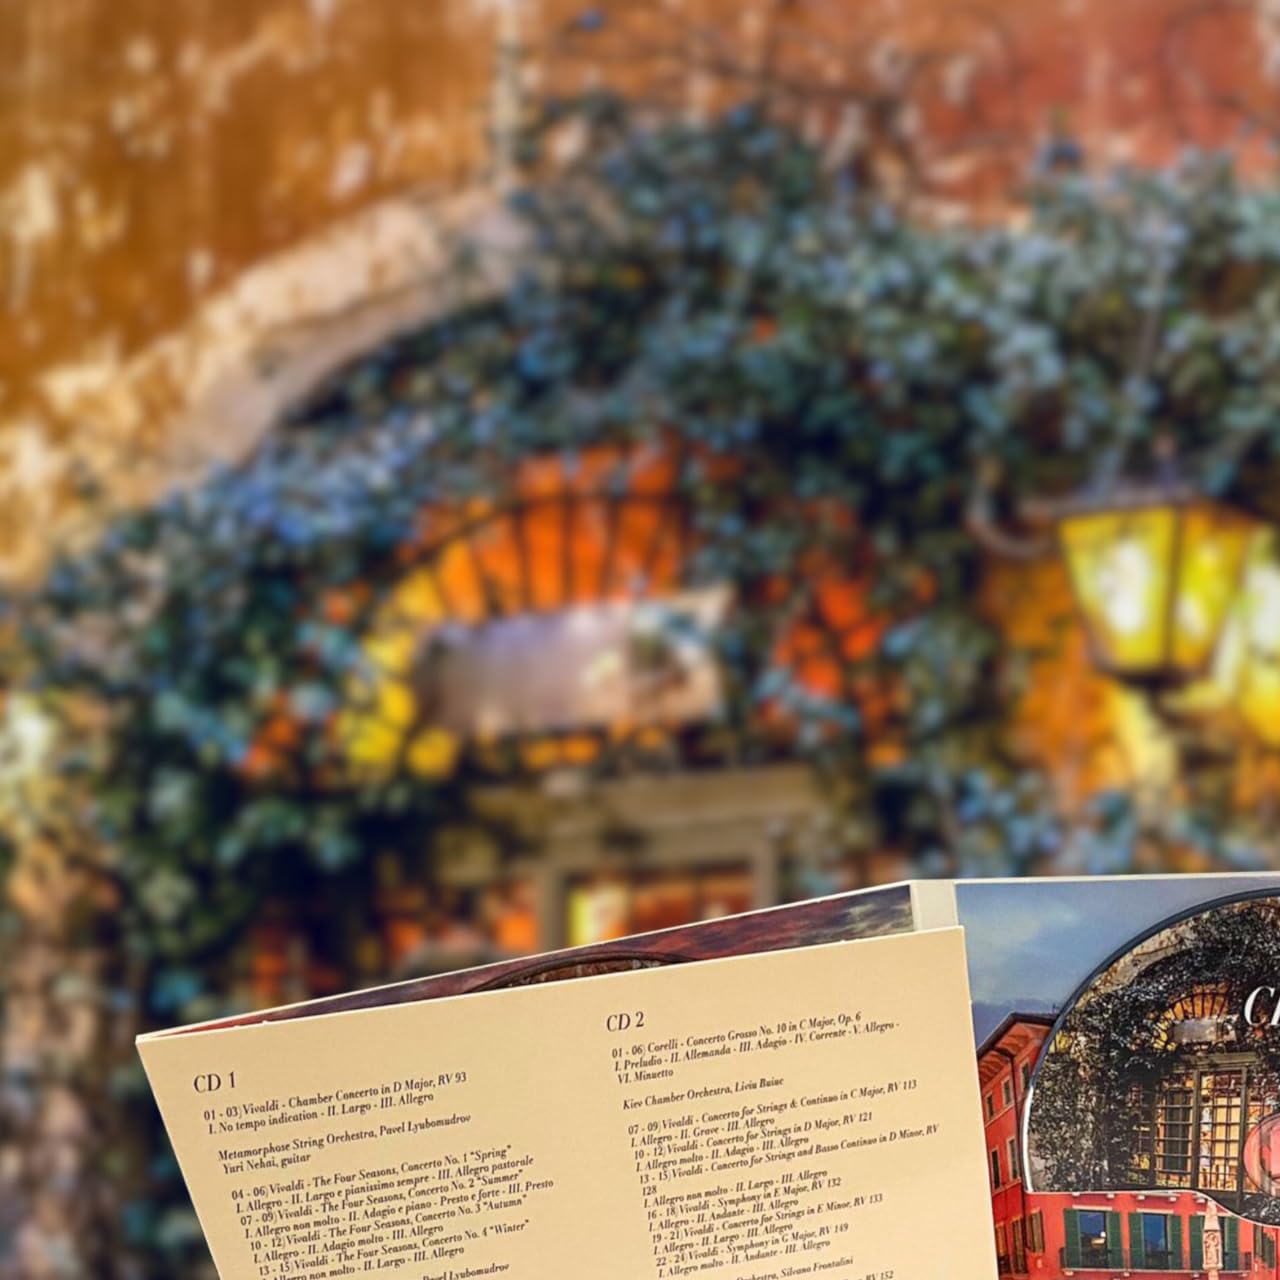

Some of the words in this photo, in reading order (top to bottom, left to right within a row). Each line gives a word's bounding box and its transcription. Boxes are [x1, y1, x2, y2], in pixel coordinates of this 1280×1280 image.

[606, 1013, 631, 1032] CD
[635, 1011, 644, 1028] 2
[611, 1048, 622, 1058] 01
[647, 1038, 678, 1053] Corelli
[686, 1034, 726, 1047] Concerto
[727, 1030, 758, 1041] Grosso
[777, 1022, 787, 1034] 10
[623, 1055, 663, 1071] Preludio
[683, 1044, 731, 1061] Allemanda
[755, 1036, 787, 1050] Adagio
[809, 1025, 848, 1041] Corrente
[864, 1021, 894, 1034] Allegro
[193, 1073, 222, 1093] CD
[229, 1071, 235, 1088] 1
[634, 1069, 674, 1082] Minuetto
[203, 1109, 216, 1121] 01
[242, 1099, 279, 1115] Vivaldi
[288, 1092, 334, 1108] Chamber
[335, 1088, 379, 1101] Concerto
[438, 1073, 453, 1086] RV
[455, 1072, 467, 1083] 93
[644, 1091, 685, 1106] Chamber
[219, 1121, 234, 1133] No
[235, 1119, 266, 1132] tempo
[268, 1110, 318, 1126] indication
[341, 1103, 372, 1115] Largo
[398, 1093, 434, 1106] Allegro
[628, 1124, 639, 1135] 07
[660, 1115, 694, 1129] Vivaldi
[701, 1111, 740, 1123] Concerto
[740, 1105, 755, 1120] for
[755, 1102, 788, 1118] Strings
[800, 1094, 839, 1107] Continuo
[887, 1082, 901, 1092] RV
[218, 1142, 290, 1160] Metamorphose
[292, 1136, 325, 1150] String
[379, 1122, 405, 1136] Pavel
[692, 1126, 719, 1138] Grave
[706, 1135, 744, 1148] Concerto
[760, 1126, 792, 1142] Strings
[842, 1114, 856, 1125] RV
[858, 1112, 872, 1122] 121
[840, 1137, 878, 1149] Continuo
[223, 1161, 244, 1174] Yuri
[280, 1153, 311, 1169] guitar
[231, 1189, 244, 1200] 04
[269, 1179, 305, 1194] Vivaldi
[312, 1175, 332, 1187] The
[334, 1173, 357, 1184] Four
[400, 1160, 442, 1173] Concerto
[246, 1199, 283, 1216] Allegro
[305, 1191, 336, 1206] Largo
[343, 1180, 395, 1200] pianissimo
[396, 1175, 430, 1190] sempre
[455, 1166, 489, 1179] Allegro
[491, 1156, 534, 1175] pastorale
[642, 1185, 657, 1197] 128
[747, 1179, 774, 1191] Largo
[341, 1198, 365, 1210] Four
[408, 1185, 449, 1198] Concerto
[362, 1205, 396, 1221] Adagio
[405, 1200, 432, 1216] piano
[440, 1194, 470, 1207] Presto
[476, 1189, 500, 1204] forte
[717, 1193, 762, 1210] Symphony
[414, 1210, 456, 1223] Concerto
[321, 1238, 356, 1256] Adagio
[409, 1225, 444, 1239] Allegro
[421, 1234, 463, 1248] Concerto
[377, 1257, 406, 1269] Largo
[430, 1246, 464, 1260] Allegro
